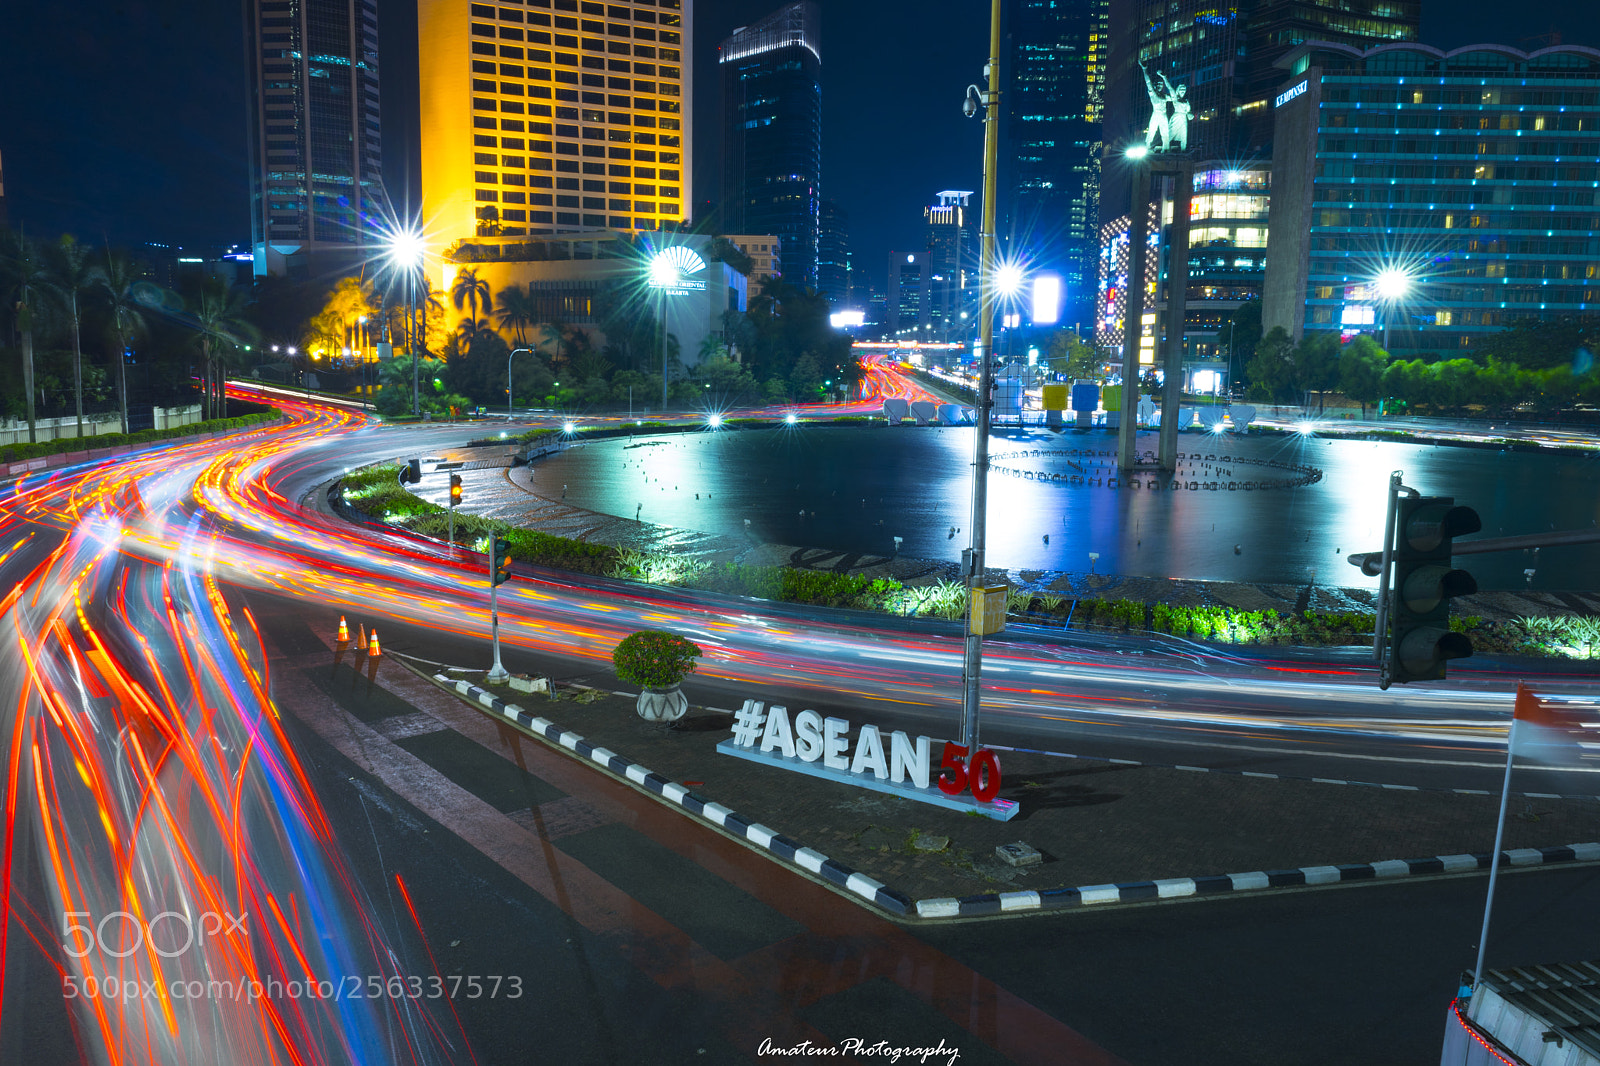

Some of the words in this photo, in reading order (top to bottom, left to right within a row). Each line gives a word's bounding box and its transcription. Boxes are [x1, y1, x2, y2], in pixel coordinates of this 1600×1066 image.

[1275, 79, 1308, 108] KEMPINSKI
[731, 699, 931, 789] #ASEAN
[938, 740, 1001, 803] 50
